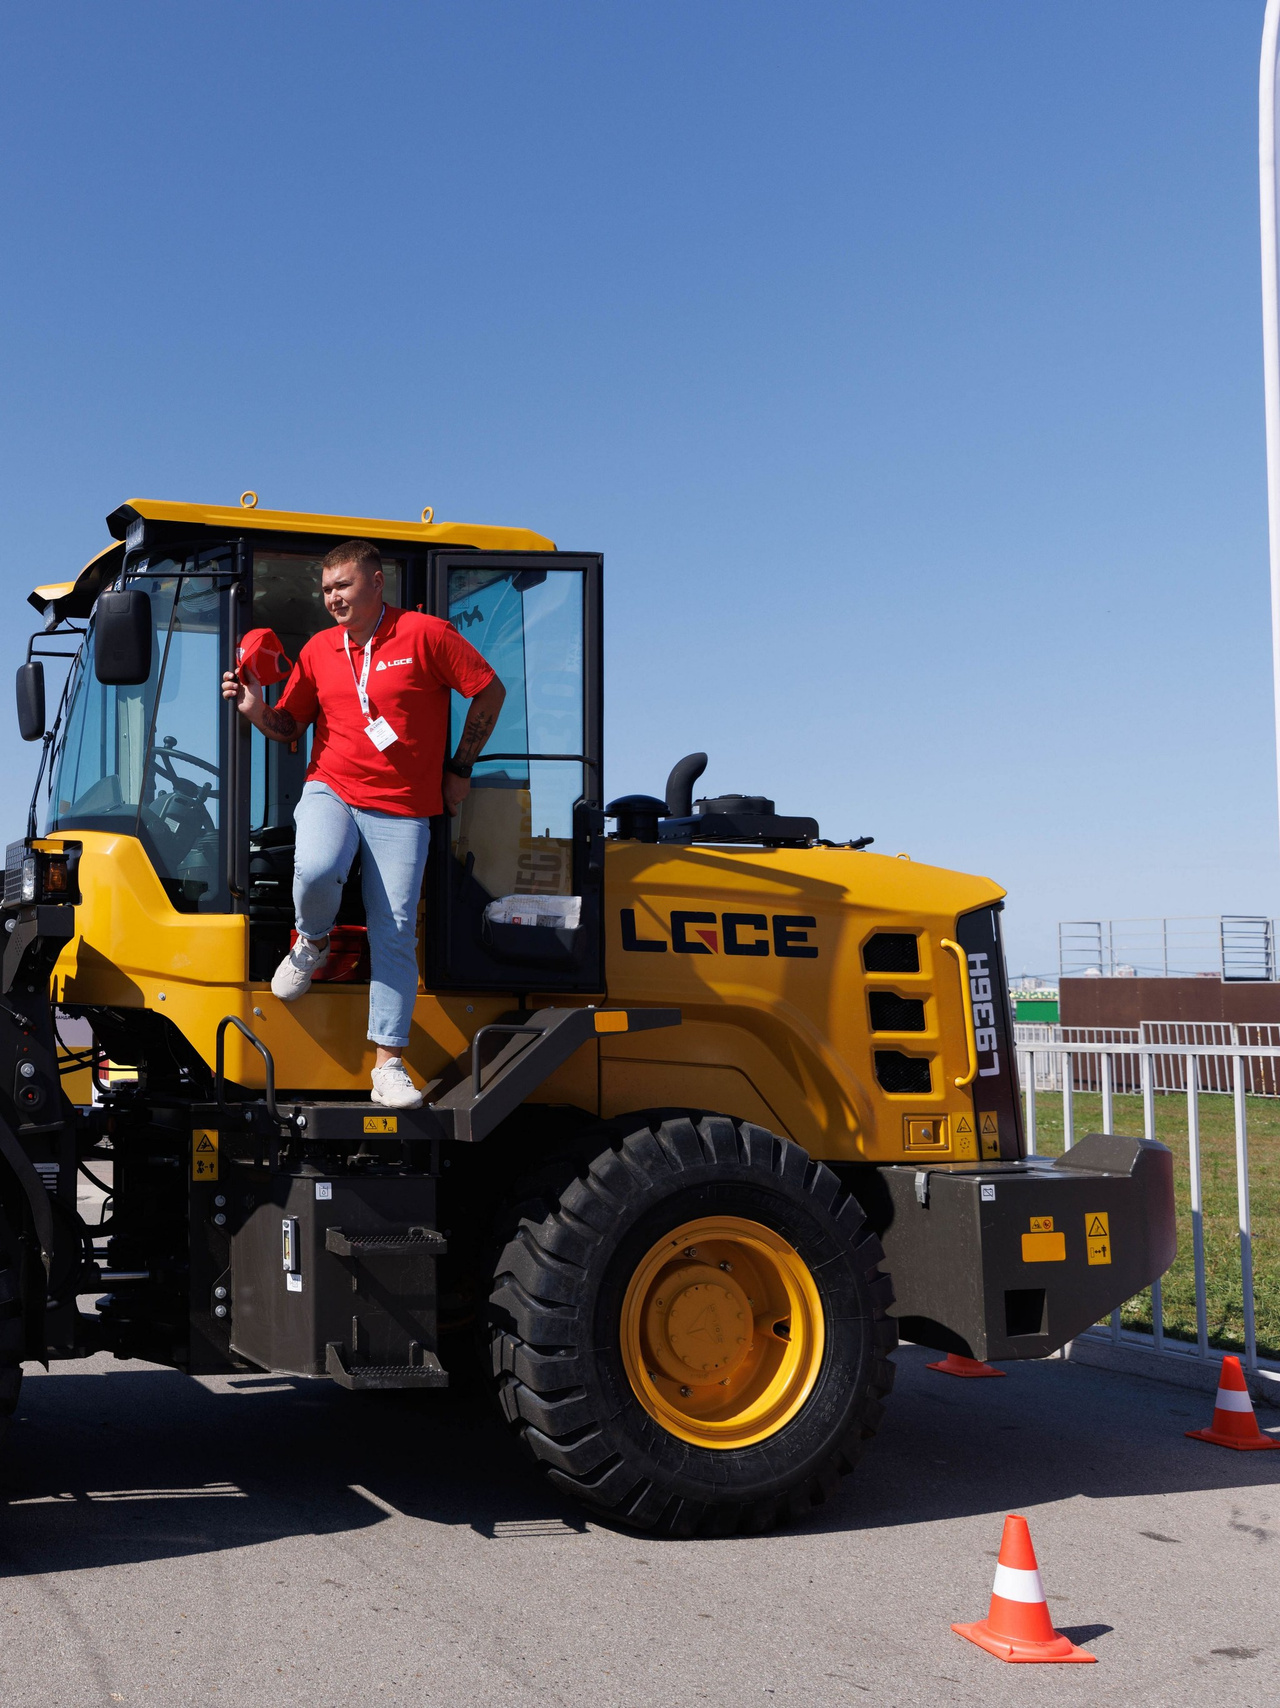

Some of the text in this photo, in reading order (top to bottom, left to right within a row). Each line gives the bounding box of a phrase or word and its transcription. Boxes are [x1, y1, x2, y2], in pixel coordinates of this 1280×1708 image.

[387, 657, 413, 667] LGCE
[620, 908, 819, 959] LGCE
[967, 952, 1000, 1077] L936H
